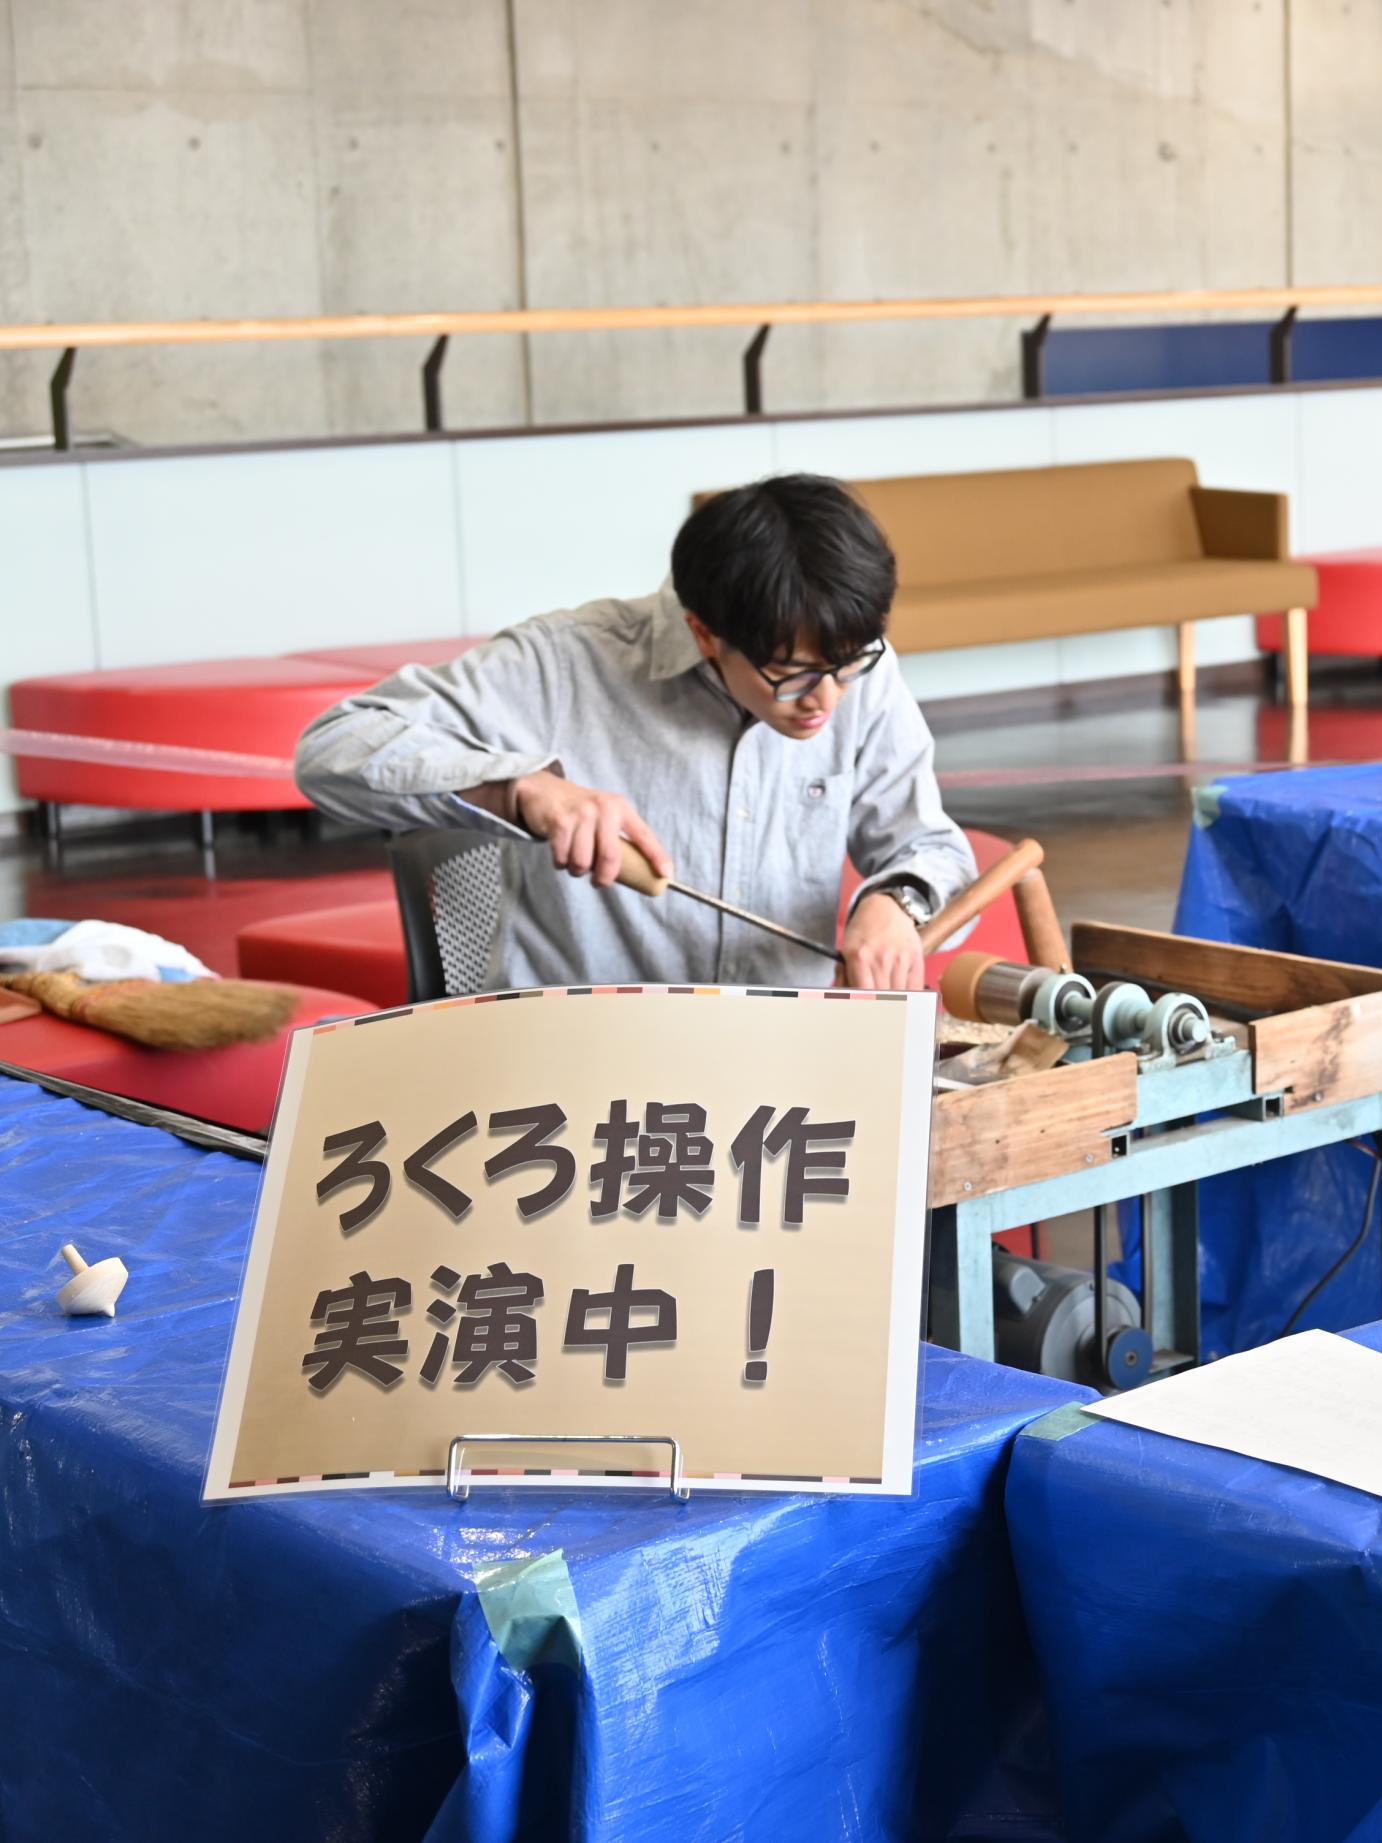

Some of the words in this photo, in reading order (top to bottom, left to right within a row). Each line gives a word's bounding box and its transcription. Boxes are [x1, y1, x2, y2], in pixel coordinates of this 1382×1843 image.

[315, 1098, 858, 1234] ろくろ操作
